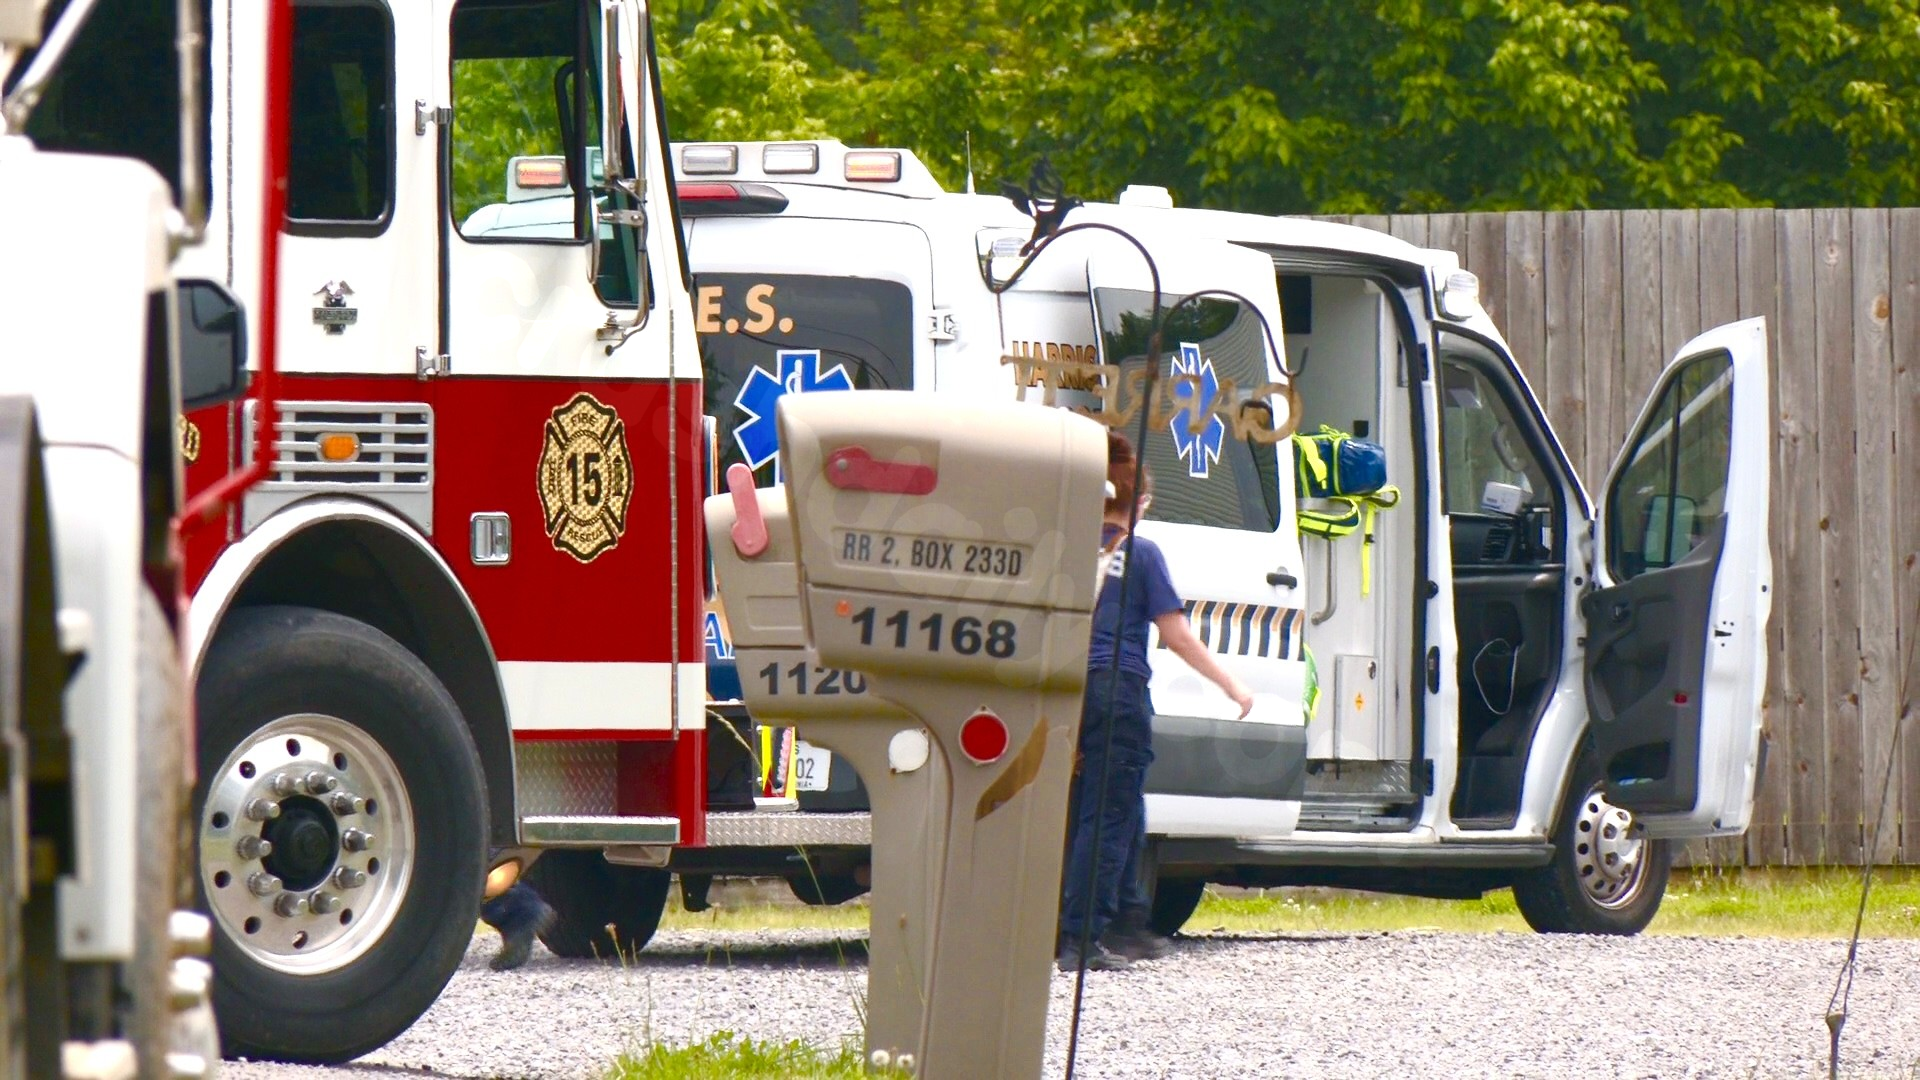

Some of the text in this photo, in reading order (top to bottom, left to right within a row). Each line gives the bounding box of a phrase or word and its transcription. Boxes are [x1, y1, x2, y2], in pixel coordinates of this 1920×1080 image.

[571, 412, 598, 427] FIRE
[566, 452, 602, 507] 15
[567, 527, 604, 543] RESCUE
[843, 533, 871, 561] RR
[911, 539, 954, 571] BOX
[851, 606, 1017, 660] 11168
